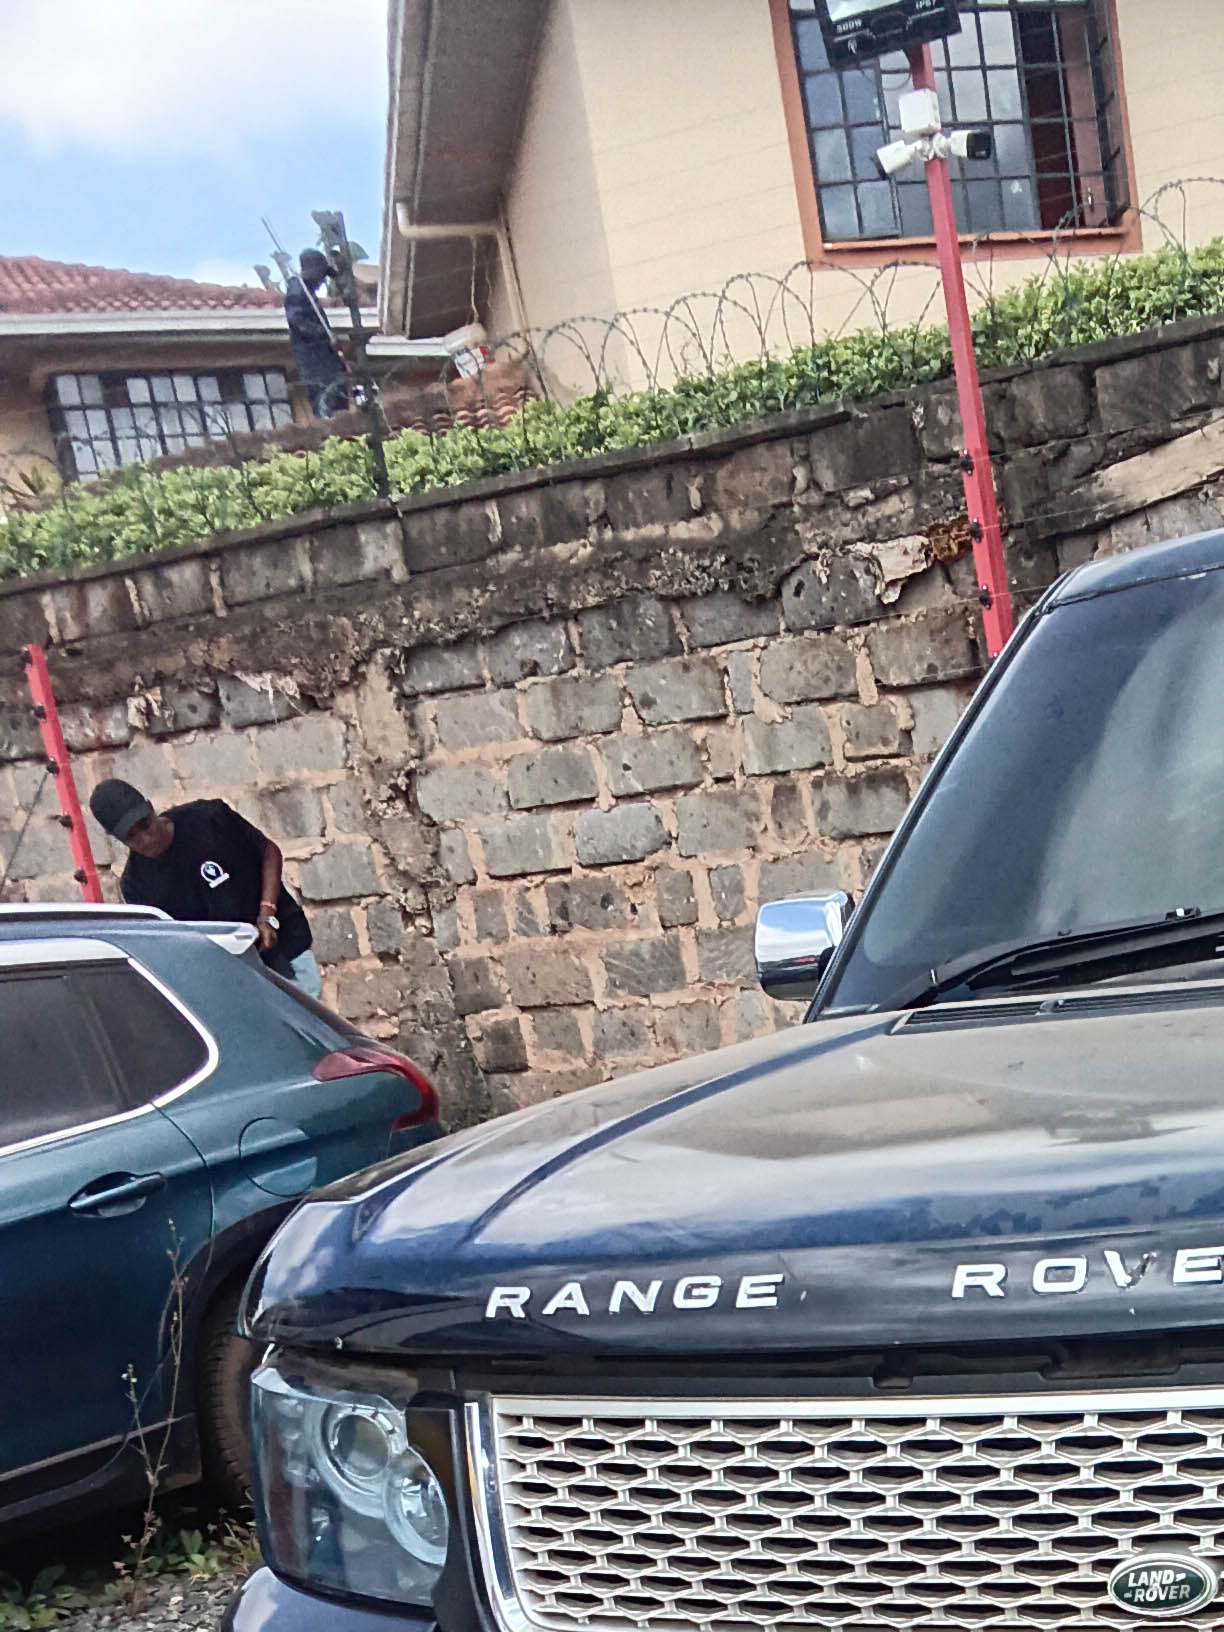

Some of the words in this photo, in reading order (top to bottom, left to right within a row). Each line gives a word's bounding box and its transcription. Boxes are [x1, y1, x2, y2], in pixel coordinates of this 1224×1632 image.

[485, 1273, 784, 1319] RANGE
[1128, 1569, 1174, 1588] LAND
[1133, 1584, 1191, 1603] ROVER
